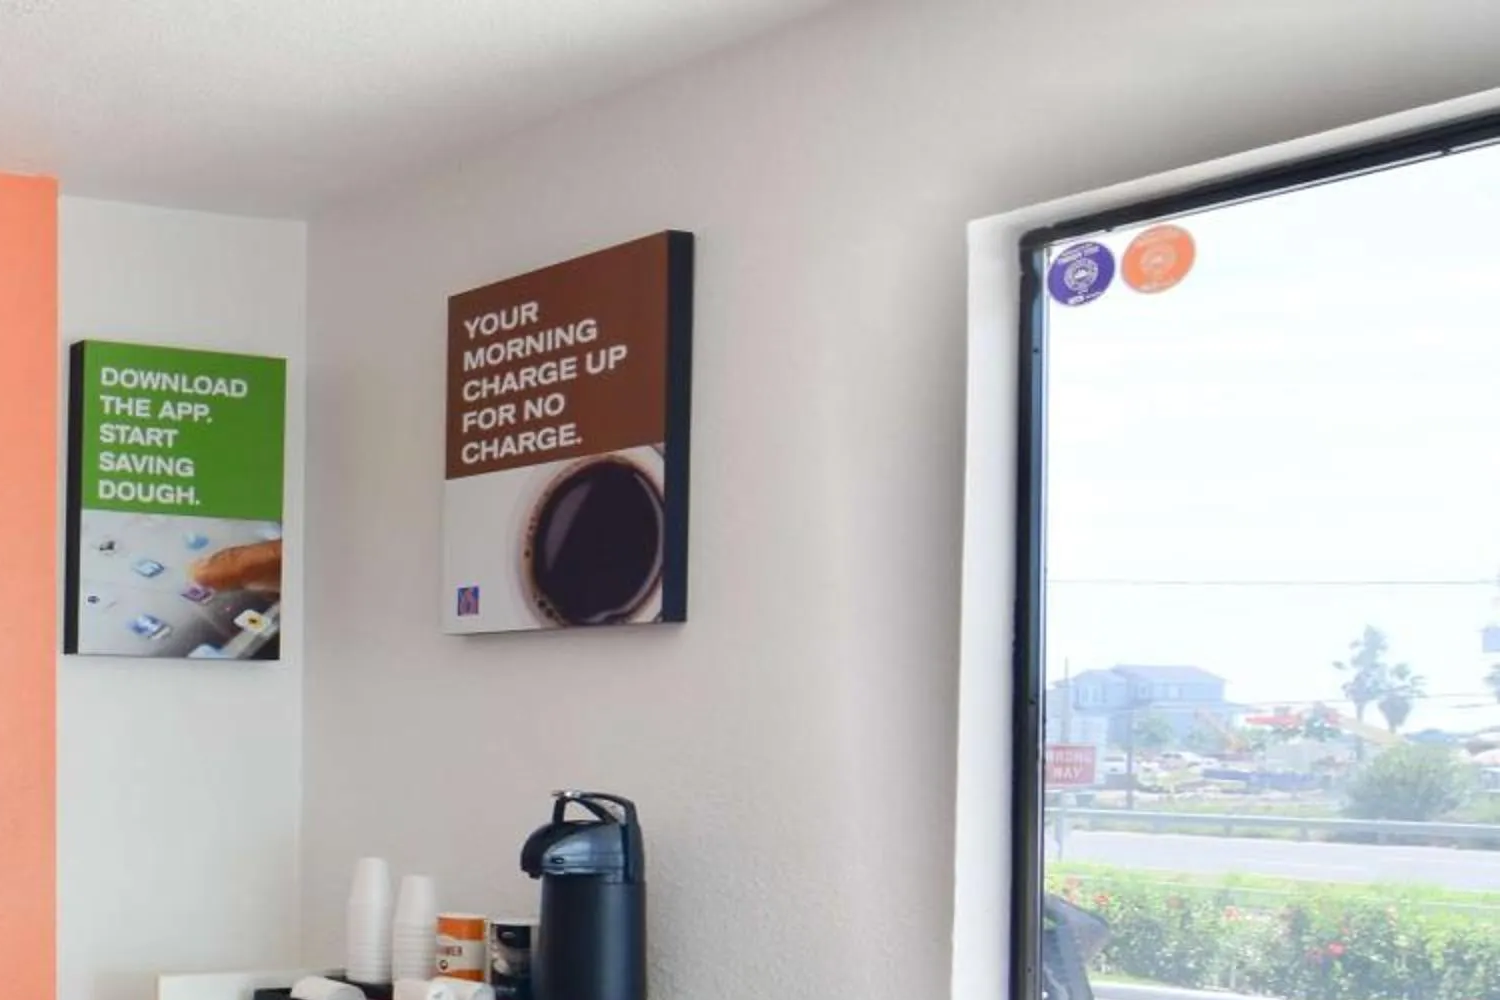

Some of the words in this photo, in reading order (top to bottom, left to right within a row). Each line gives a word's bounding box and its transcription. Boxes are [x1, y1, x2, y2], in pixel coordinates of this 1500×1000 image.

[464, 301, 539, 339] YOUR
[463, 318, 598, 372] MORNING
[100, 366, 248, 398] DOWNLOAD
[462, 356, 578, 402] CHARGE
[585, 344, 628, 375] UP
[100, 395, 151, 419] THE
[158, 400, 213, 424] APP.
[462, 404, 515, 434] FOR
[524, 393, 565, 422] NO
[99, 423, 179, 449] START
[460, 422, 583, 465] CHARGE.
[99, 452, 195, 478] SAVING
[98, 479, 201, 506] DOUGH.
